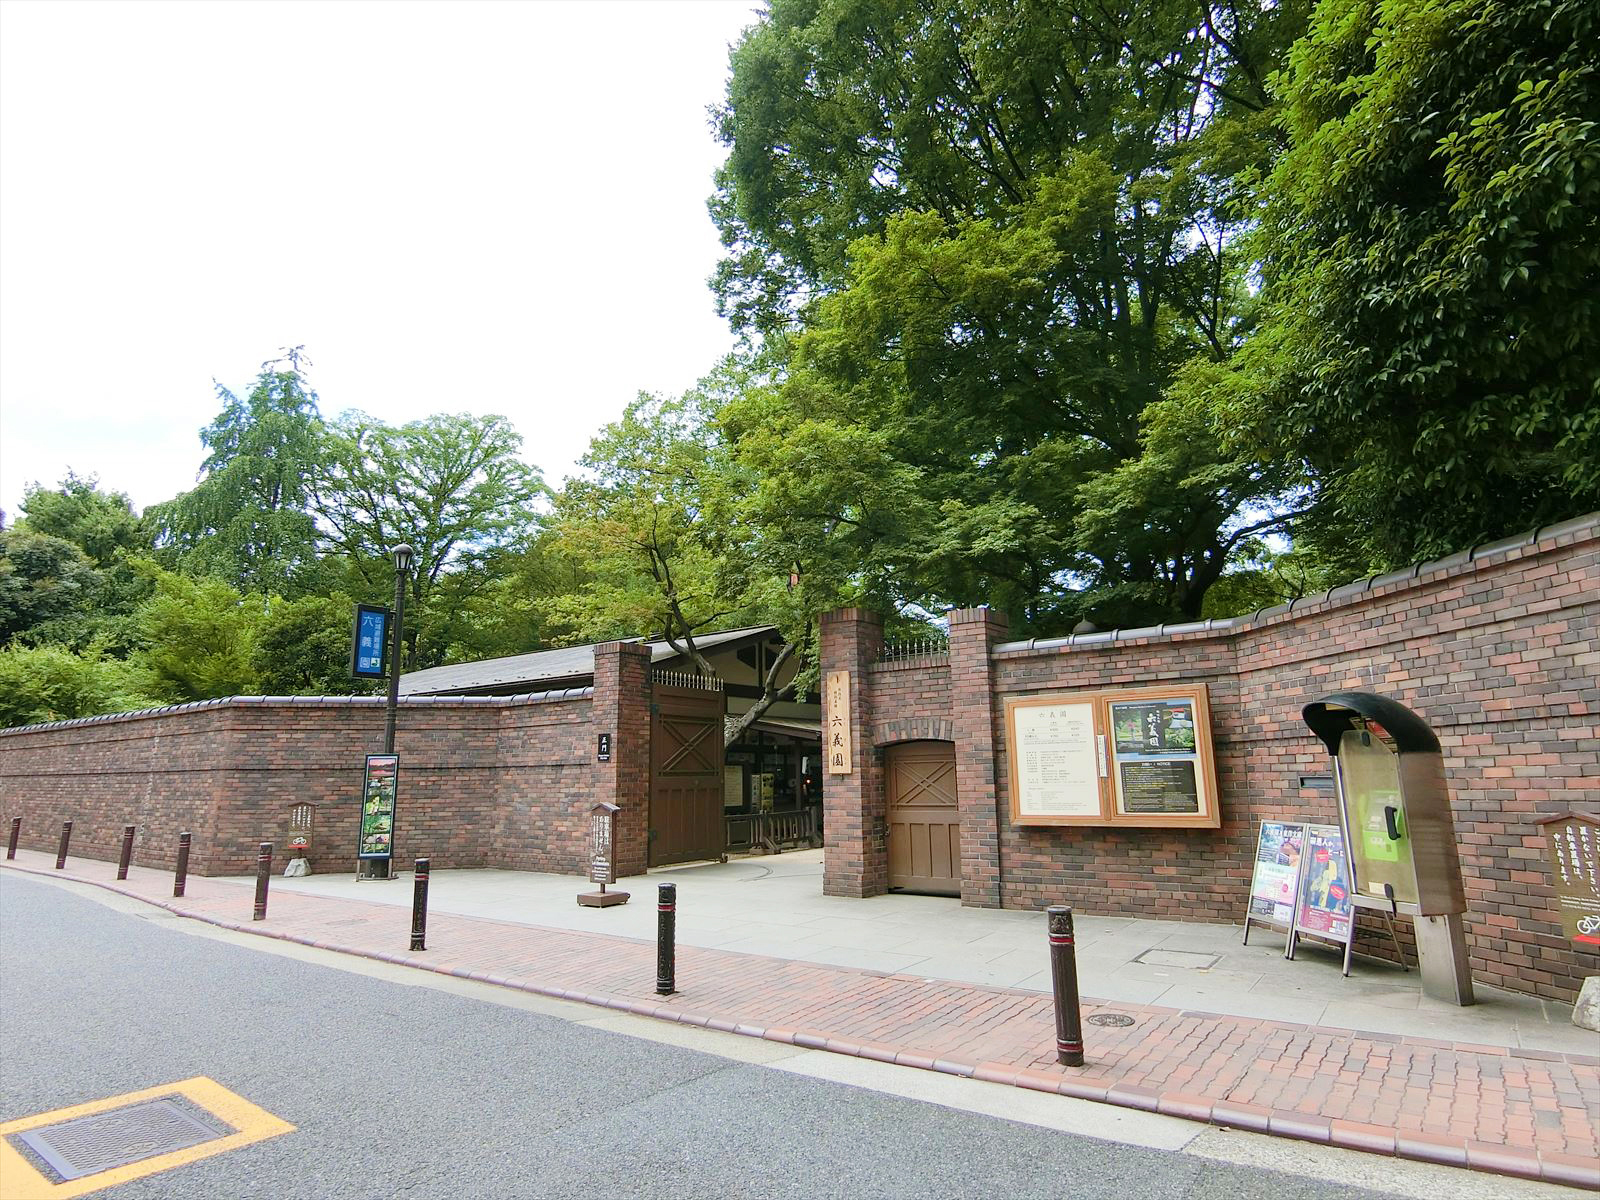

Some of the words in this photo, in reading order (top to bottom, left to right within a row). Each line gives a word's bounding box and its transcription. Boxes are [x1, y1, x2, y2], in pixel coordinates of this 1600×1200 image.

[360, 615, 374, 668] 六義園
[832, 715, 844, 767] 六義園
